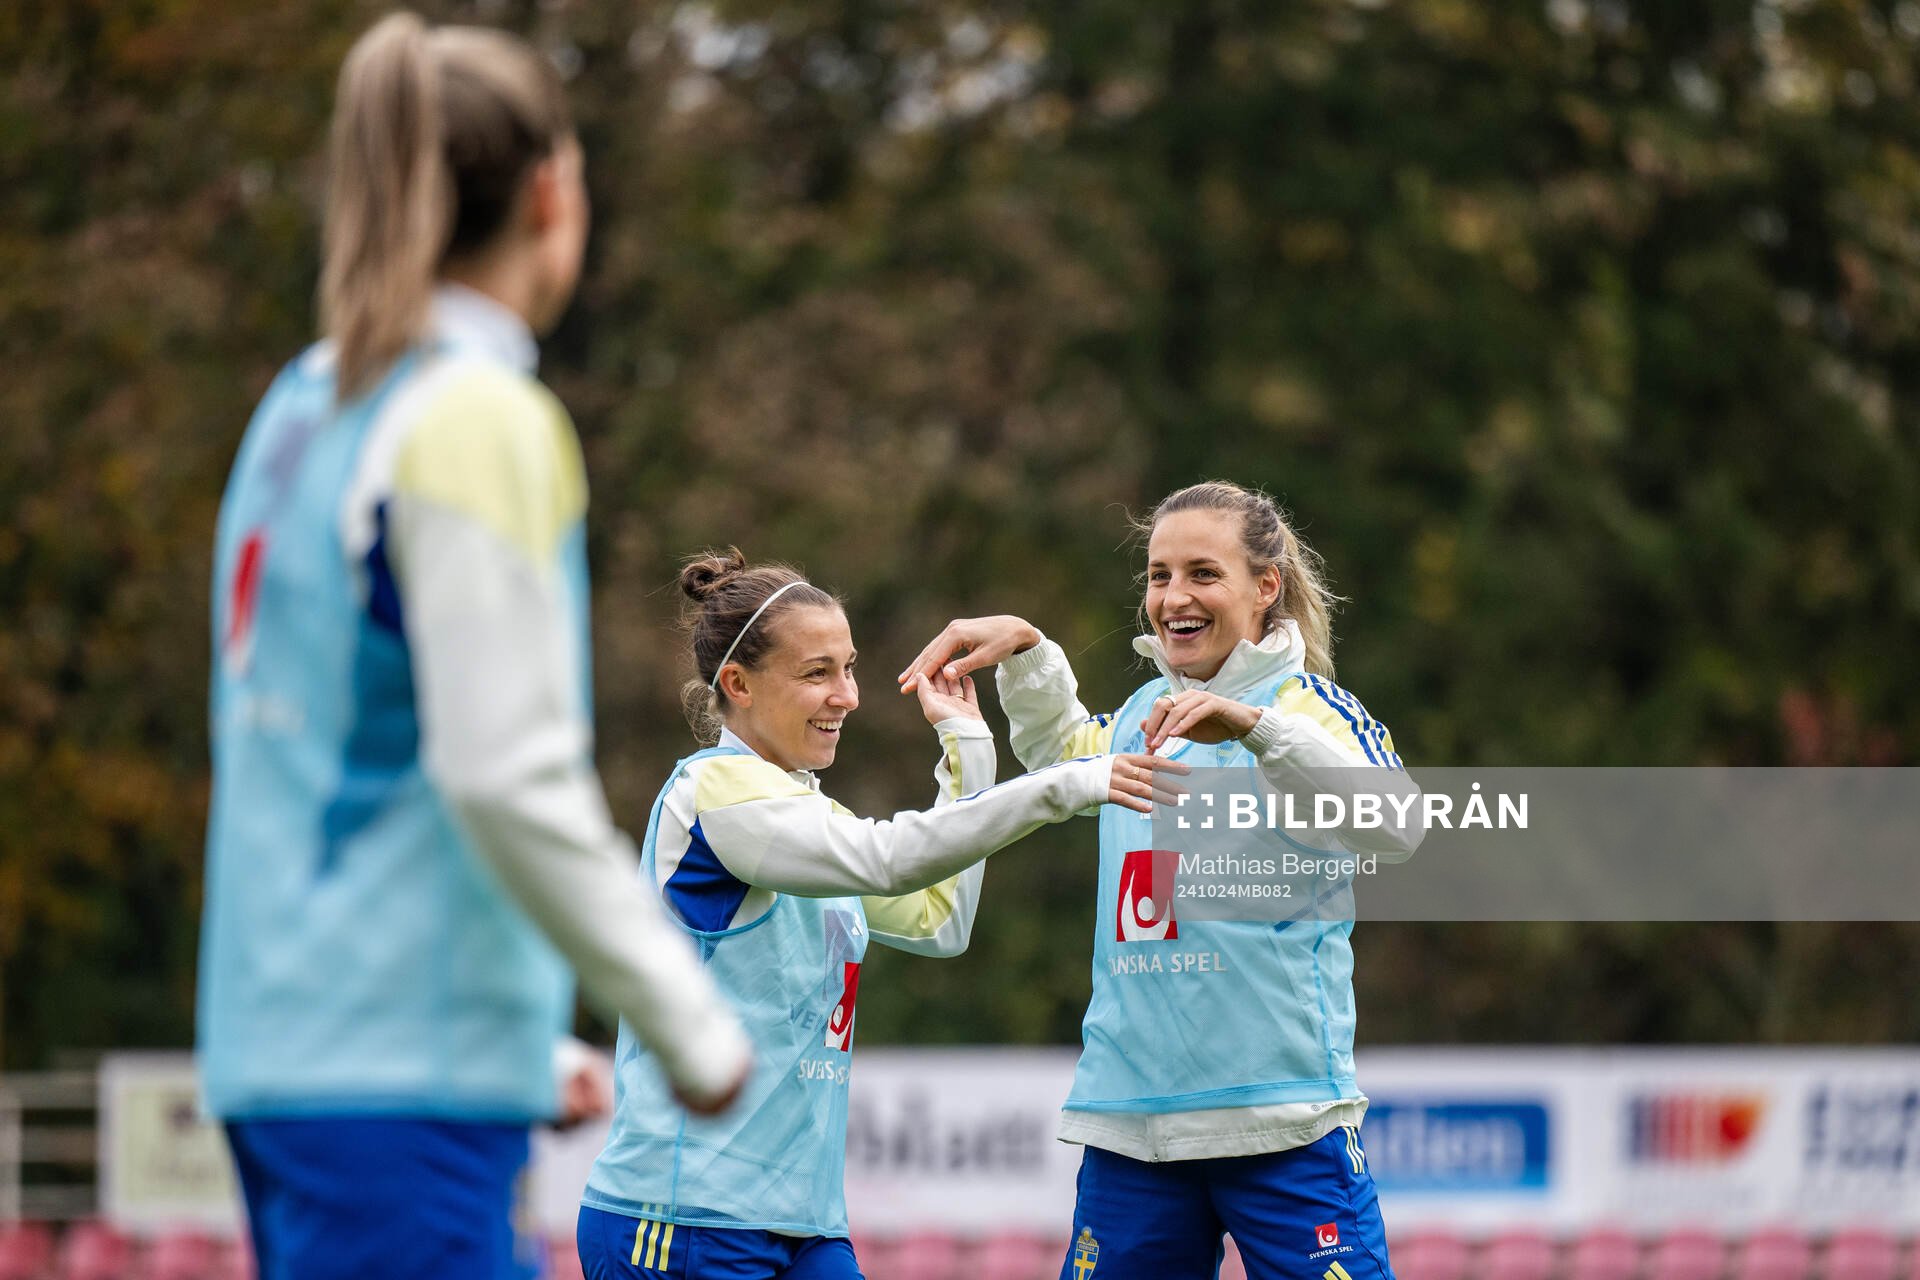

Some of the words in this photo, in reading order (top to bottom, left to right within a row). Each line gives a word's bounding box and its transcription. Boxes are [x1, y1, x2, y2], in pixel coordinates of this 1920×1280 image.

[1170, 951, 1227, 973] SPEL
[1309, 1248, 1338, 1260] SVENSKA
[1338, 1245, 1354, 1253] SPEL
